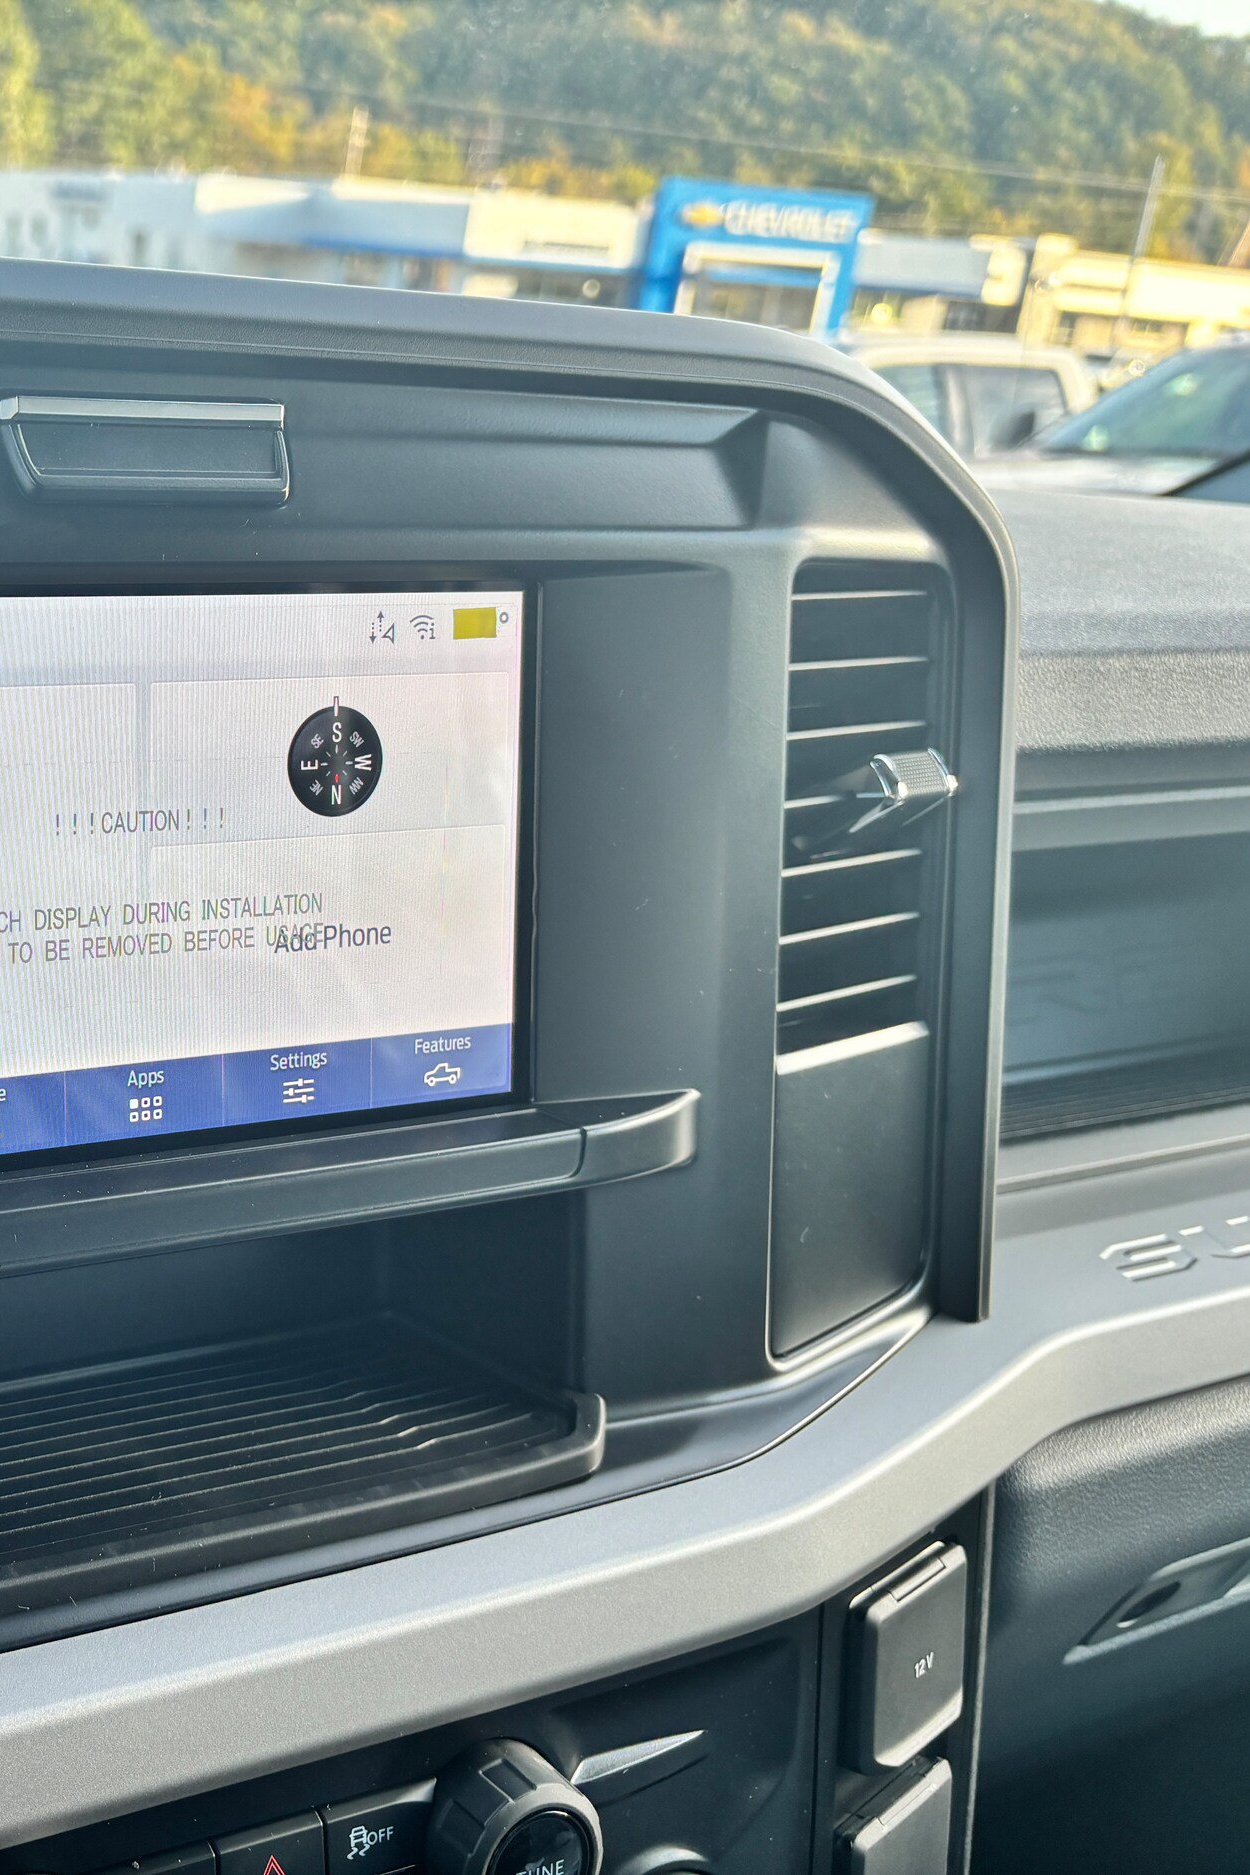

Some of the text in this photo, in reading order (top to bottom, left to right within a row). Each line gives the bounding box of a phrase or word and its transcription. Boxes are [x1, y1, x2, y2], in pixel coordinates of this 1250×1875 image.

[724, 200, 858, 244] CHEVROLET
[332, 722, 342, 743] S
[301, 759, 319, 771] E
[354, 753, 372, 771] W
[331, 784, 342, 806] N
[35, 905, 112, 931] DISPLAY
[123, 900, 191, 925] DURING
[201, 893, 323, 920] INSTALLATION
[8, 941, 33, 964] TO
[45, 939, 71, 962] BE
[82, 932, 173, 959] REMOVED
[184, 926, 255, 952] BEFORE
[266, 923, 323, 947] USAGE
[274, 923, 392, 953] Add Phone
[414, 1035, 472, 1054] Features
[270, 1051, 328, 1071] Settings
[127, 1069, 165, 1088] Apps
[914, 1651, 934, 1679] 12V
[367, 1826, 395, 1846] OFF
